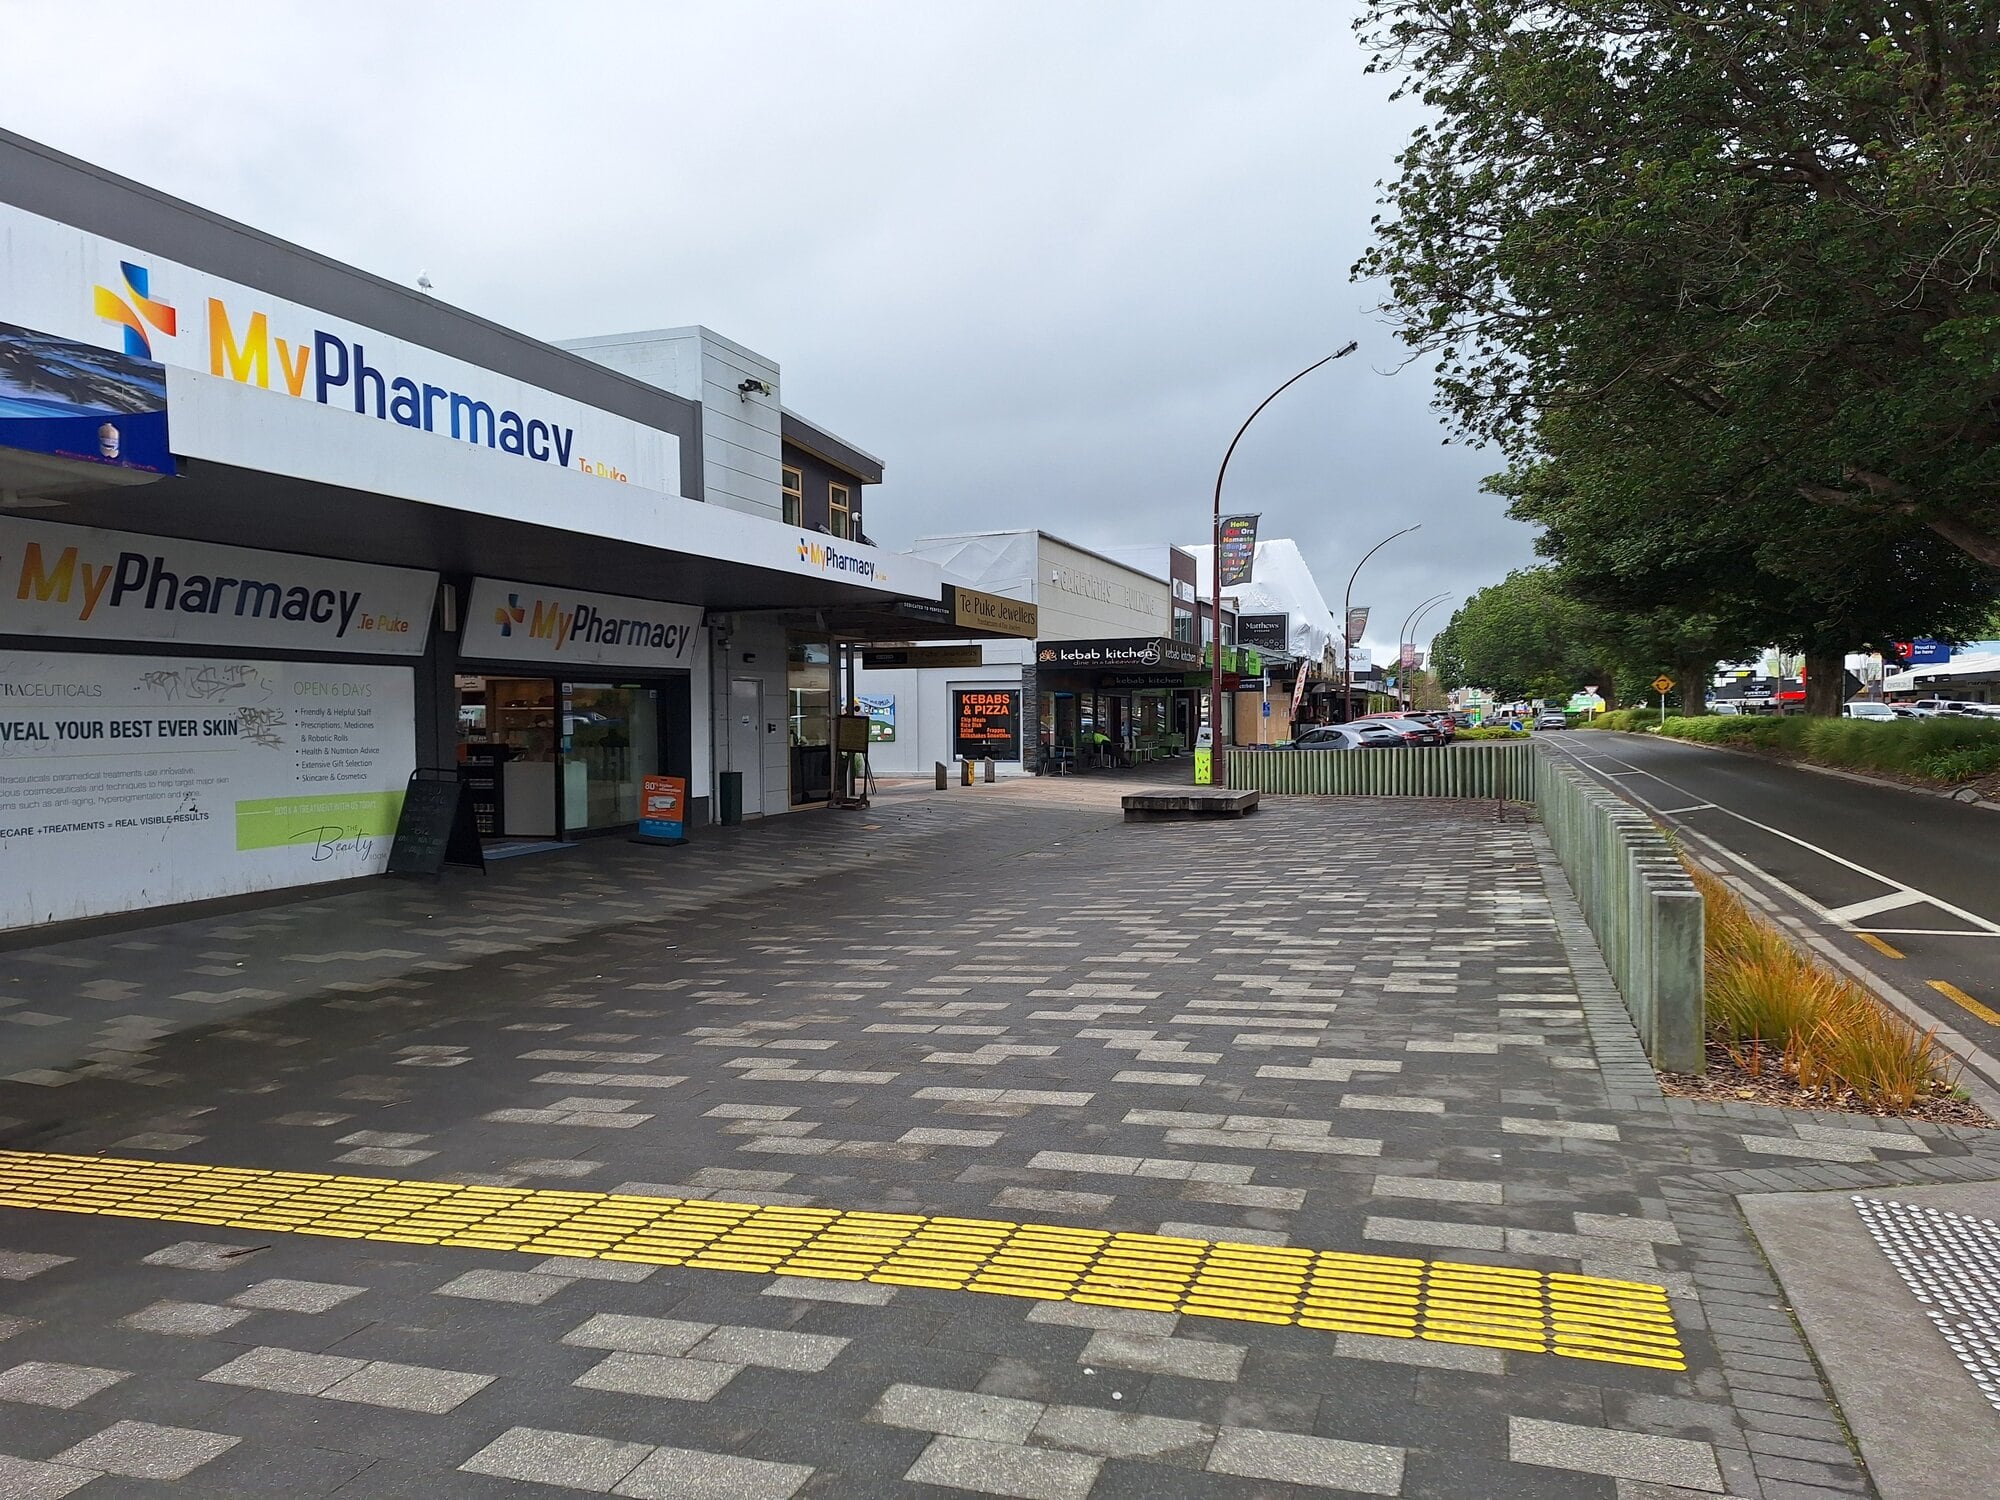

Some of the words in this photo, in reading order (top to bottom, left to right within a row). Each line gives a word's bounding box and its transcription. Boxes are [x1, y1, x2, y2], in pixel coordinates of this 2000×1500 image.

[207, 296, 574, 468] MyPharmacy
[810, 542, 875, 582] MyPharmacy
[17, 541, 362, 639] MyPharmacy
[376, 613, 409, 633] Puke
[960, 594, 971, 613] Te
[974, 597, 996, 618] Puke
[998, 602, 1035, 625] Jewellers
[529, 600, 691, 659] MyPharmacy
[1245, 621, 1280, 629] Matthews
[1060, 649, 1100, 661] kebab
[1105, 647, 1153, 660] kitchen
[1149, 676, 1182, 684] kitchen
[294, 681, 328, 696] OPEN
[331, 683, 339, 696] 6
[342, 682, 372, 697] DAYS
[962, 694, 1010, 704] KEBABS
[300, 708, 325, 717] Friendly
[333, 708, 356, 717] Helpful
[357, 708, 372, 716] Staff
[963, 705, 971, 715] &
[974, 705, 1009, 715] PIZZA
[0, 722, 50, 741] VEAL
[55, 721, 104, 740] YOUR
[110, 720, 153, 738] BEST
[158, 719, 198, 738] EVER
[203, 719, 238, 736] SKIN
[301, 747, 322, 755] Health
[331, 747, 358, 755] Nutrition
[301, 761, 331, 769] Extensive
[332, 760, 344, 768] Gift
[345, 760, 372, 768] Selection
[53, 772, 101, 782] paramedical
[103, 769, 142, 779] treatments
[302, 774, 329, 782] Skincare
[89, 784, 104, 792] and
[149, 780, 156, 788] to
[19, 801, 39, 810] such
[167, 790, 181, 798] and
[0, 827, 34, 838] ECARE
[115, 819, 138, 828] REAL
[289, 825, 374, 861] Beauty
